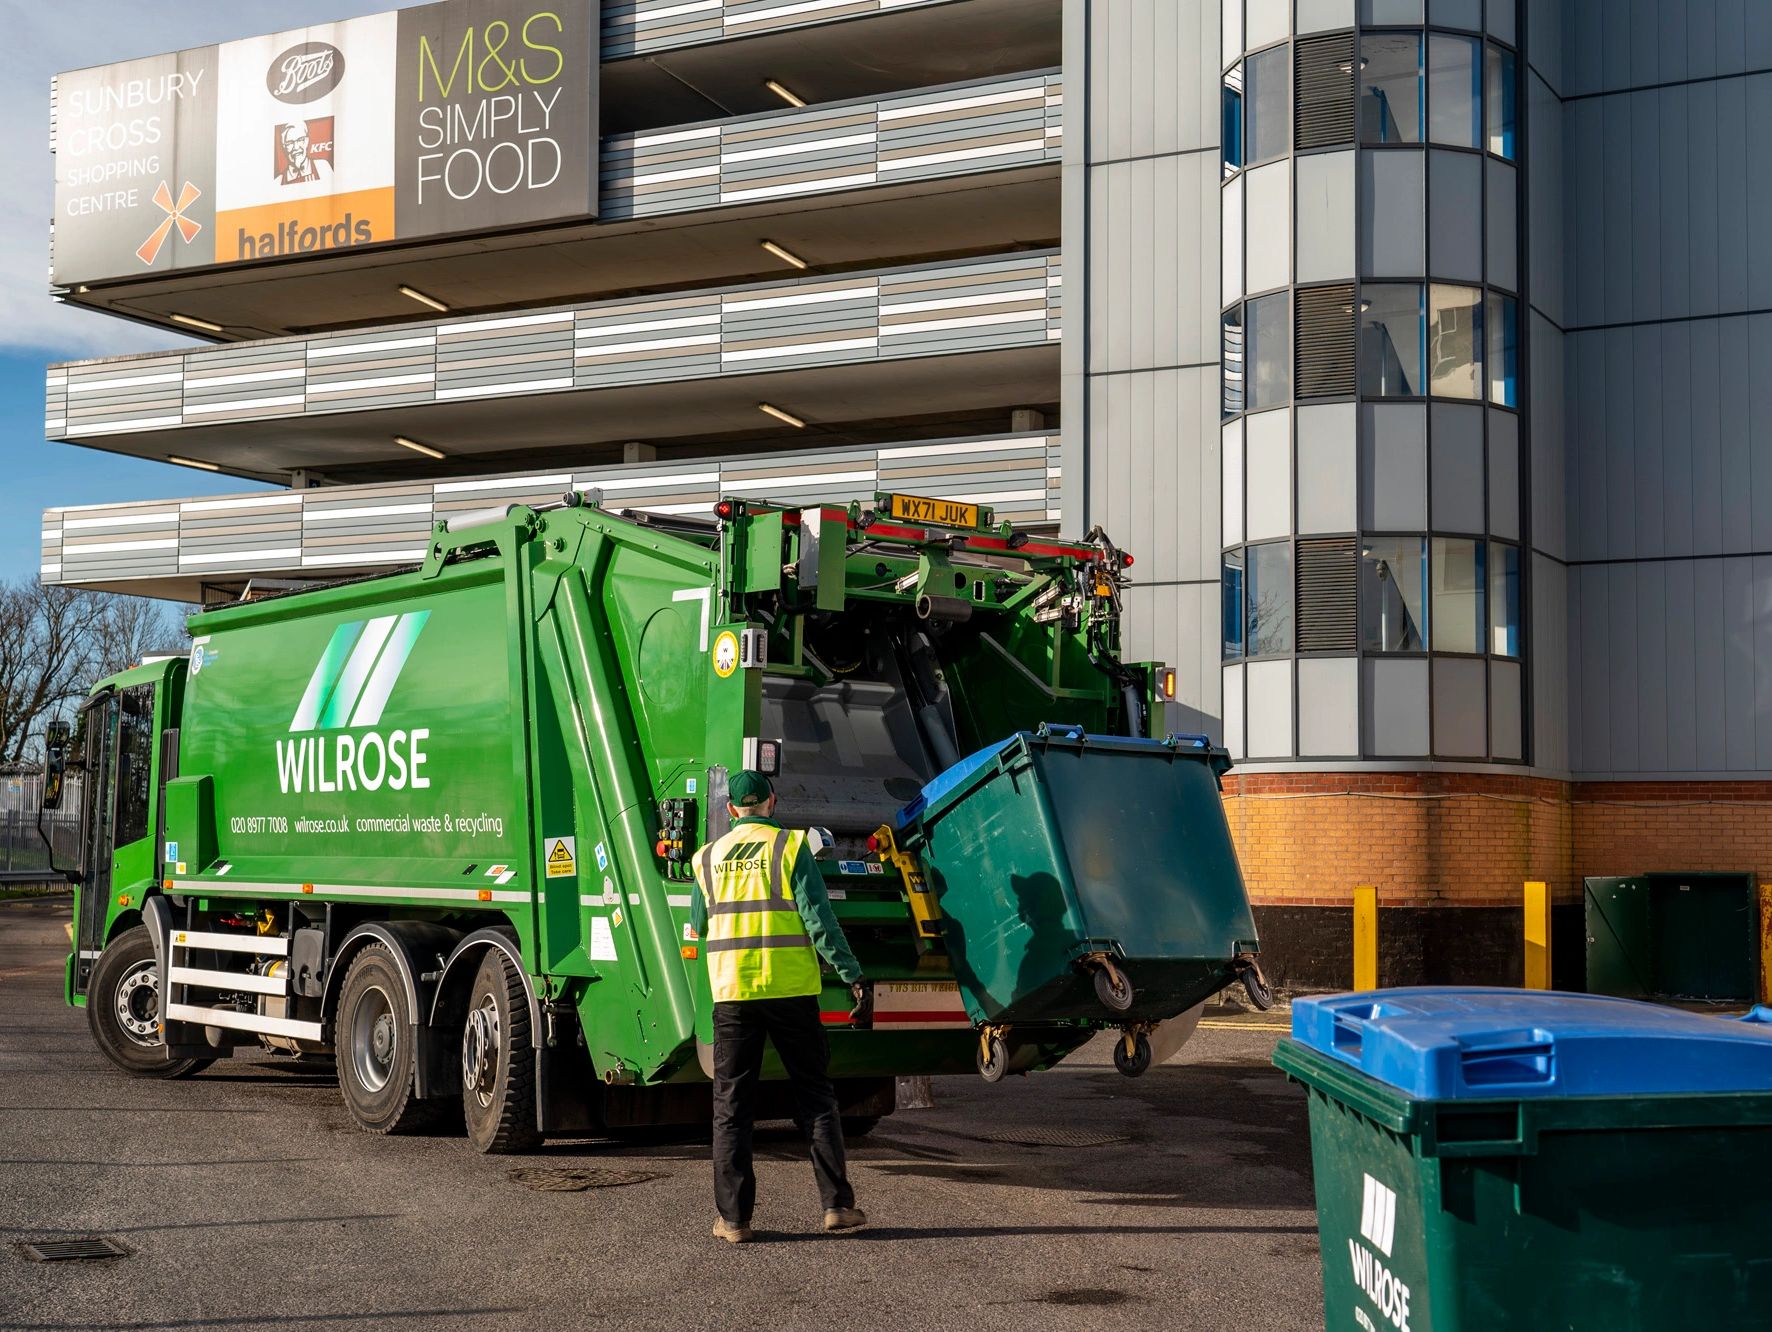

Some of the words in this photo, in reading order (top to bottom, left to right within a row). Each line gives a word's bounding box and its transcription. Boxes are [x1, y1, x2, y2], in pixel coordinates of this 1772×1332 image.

[274, 50, 334, 96] Boots
[418, 12, 564, 102] M&S
[69, 68, 205, 118] SUNBURY
[68, 116, 161, 157] CROSS
[418, 86, 563, 149] SIMPLY
[310, 141, 333, 153] KFC
[67, 155, 160, 187] SHOPPING
[418, 137, 562, 205] FOOD
[66, 189, 139, 216] CENTRE
[238, 212, 372, 261] halfords
[901, 498, 935, 520] WX71
[939, 504, 969, 525] JUK
[276, 728, 431, 794] WILROSE
[230, 816, 246, 834] 020
[247, 816, 266, 833] 8977
[267, 816, 289, 833] 7008
[294, 814, 350, 833] wilrose.co.uk
[356, 813, 411, 832] commercial
[412, 815, 442, 833] waste
[444, 813, 454, 833] &
[455, 812, 503, 838] recycling
[713, 859, 767, 874] WILROSE
[1348, 1237, 1411, 1332] WILROSE
